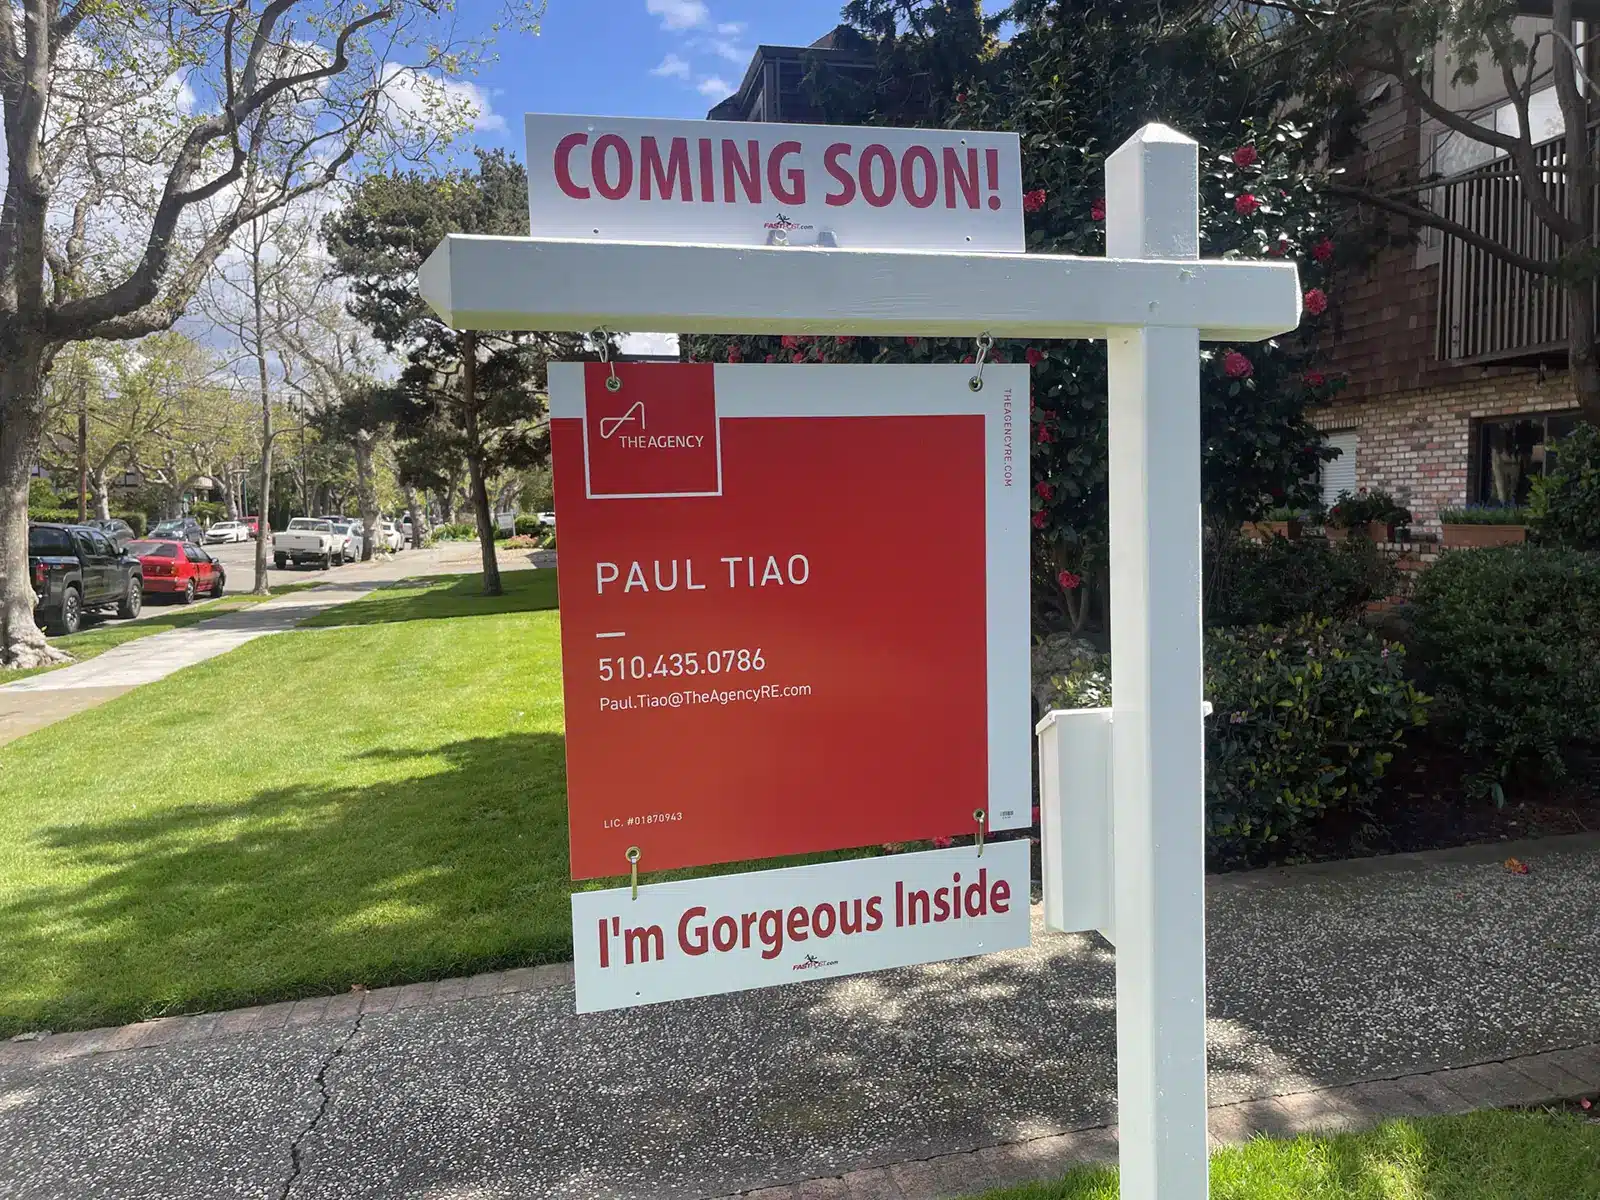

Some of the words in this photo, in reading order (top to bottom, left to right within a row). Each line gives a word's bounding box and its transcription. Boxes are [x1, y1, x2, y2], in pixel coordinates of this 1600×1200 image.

[553, 132, 806, 206] COMING
[823, 142, 1002, 212] SOON!
[1003, 388, 1012, 487] THEAGENCYRE.COM
[596, 559, 706, 594] PAUL
[720, 554, 810, 588] TIAO
[599, 648, 766, 681] 510.435.0786
[599, 684, 812, 711] Paul.Tiao@TheAgencyRE.com
[603, 818, 624, 829] LIC.
[627, 811, 683, 826] #01870943
[598, 916, 665, 969] I'm
[677, 894, 884, 961] Gorgeous
[894, 867, 1012, 929] Inside
